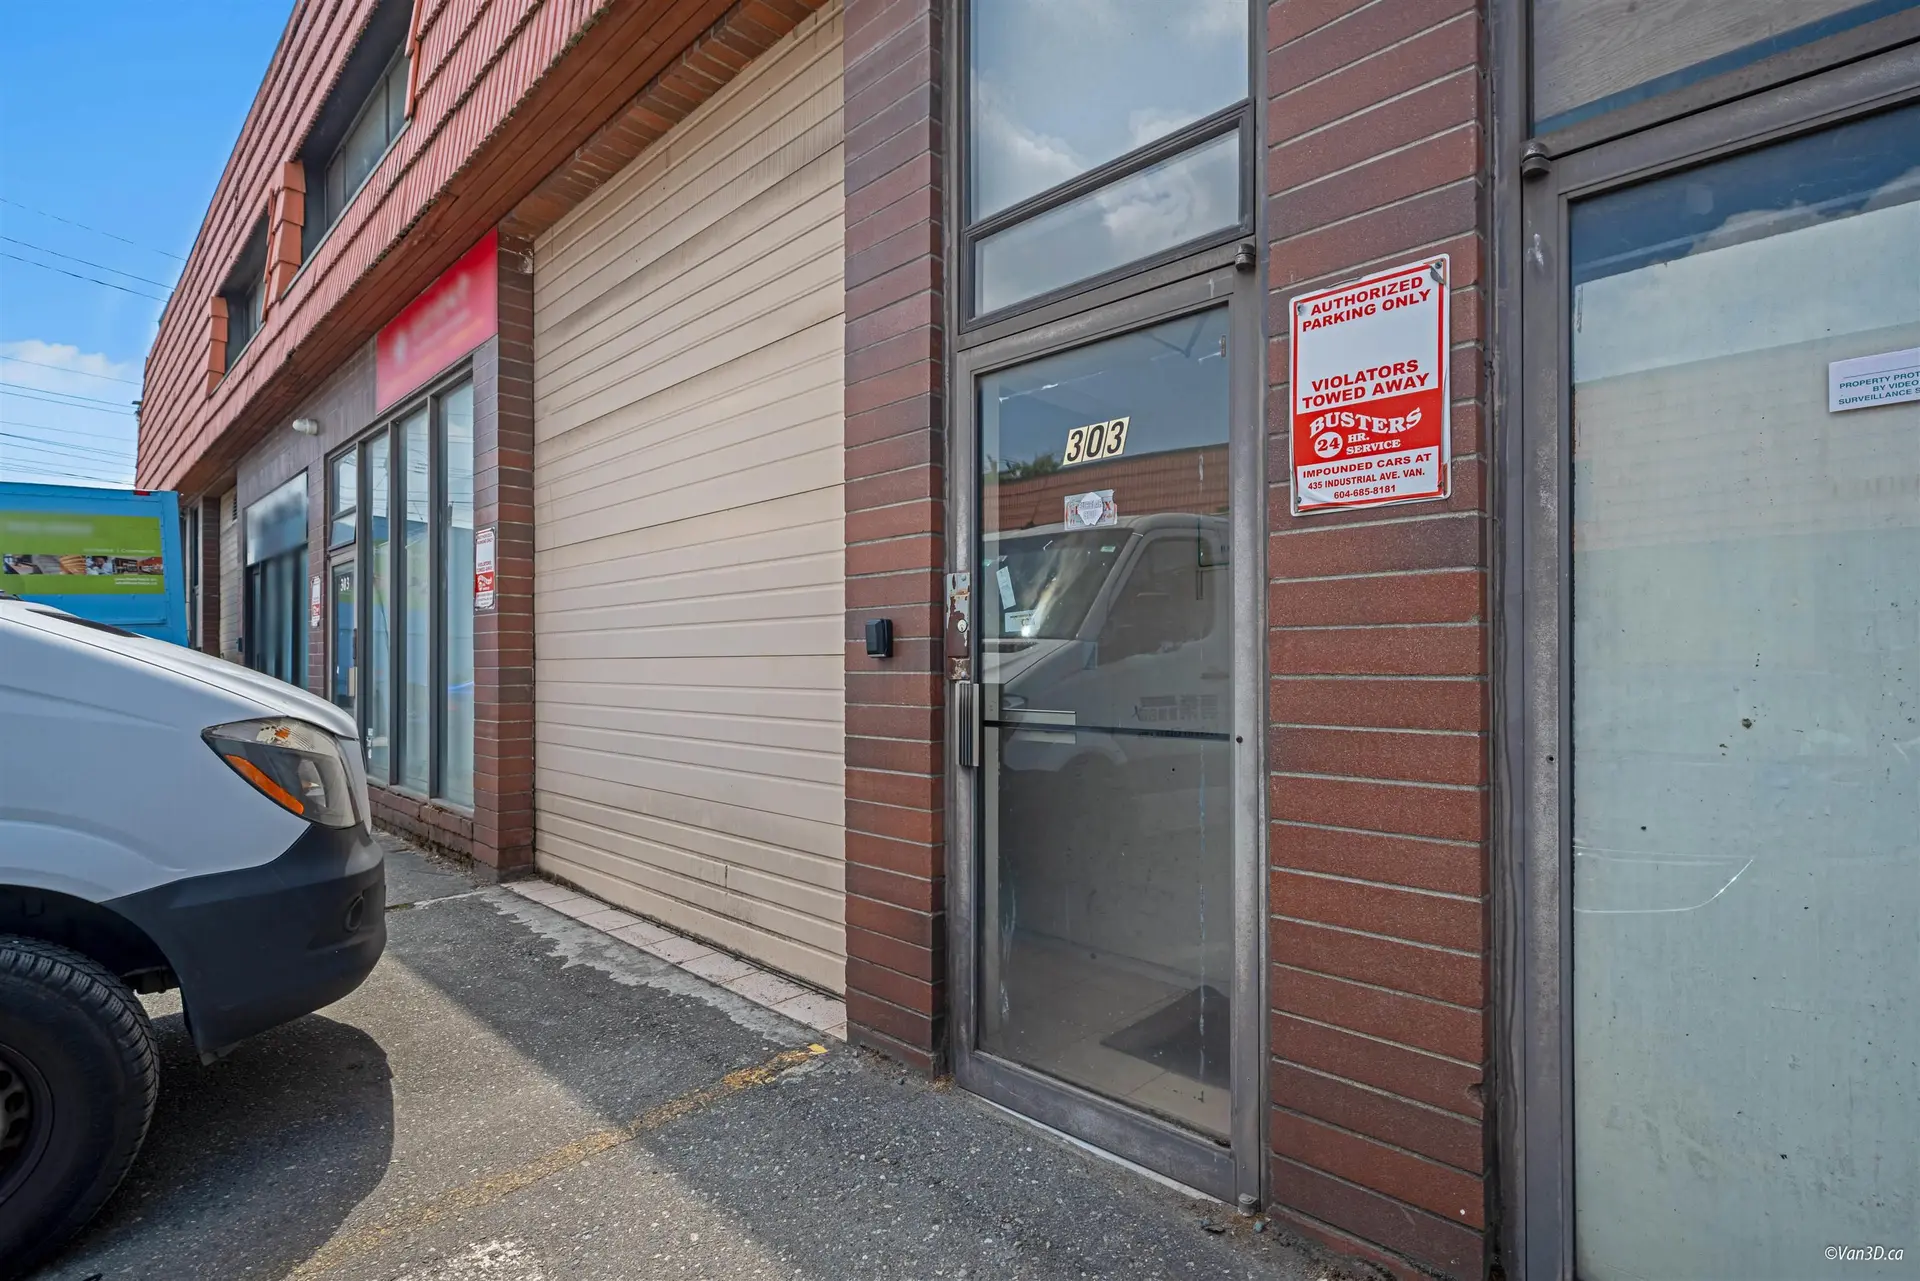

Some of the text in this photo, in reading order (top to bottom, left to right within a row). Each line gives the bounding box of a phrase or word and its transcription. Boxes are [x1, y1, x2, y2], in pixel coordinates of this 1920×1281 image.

[1310, 276, 1423, 316] AUTHORIZED
[1302, 289, 1431, 332] PARKING ONLY
[1311, 359, 1418, 392] VIOLATORS
[1839, 371, 1920, 389] PROPERTY PROT
[1872, 380, 1919, 392] BY VIDEO
[1302, 372, 1429, 409] TOWED AWAY
[1838, 388, 1912, 405] SURVEILLANCE
[1309, 407, 1422, 439] BUSTERS
[1066, 420, 1125, 462] 303
[1317, 432, 1370, 452] 24 HR.
[1346, 439, 1401, 455] SERVICE
[1303, 453, 1432, 478] IMPOUNDED CARS AT
[1307, 467, 1425, 490] 435 INDUSTRIAL AVE. VAN.
[1333, 484, 1396, 499] 604-685-8181
